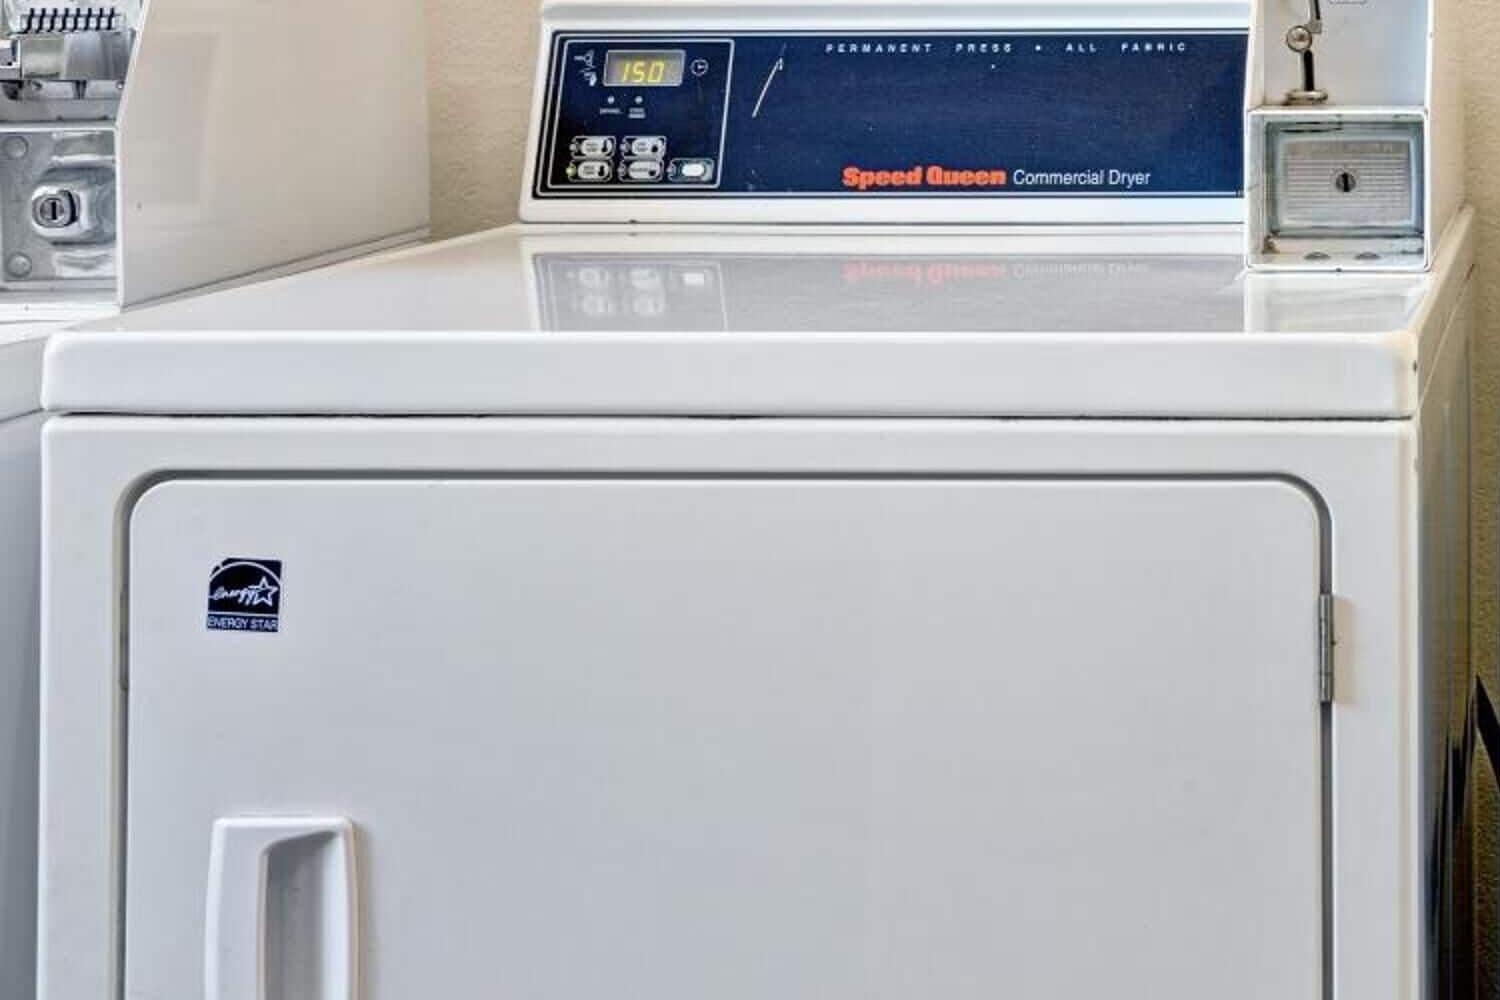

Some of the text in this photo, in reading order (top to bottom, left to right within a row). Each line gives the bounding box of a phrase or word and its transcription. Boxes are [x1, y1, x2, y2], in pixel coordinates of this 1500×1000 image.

[825, 42, 1186, 53] PERMANENT PRESS ALL FABRIC
[623, 61, 665, 83] 150
[842, 166, 1151, 190] Speed Queen Commercial Dryer
[208, 616, 279, 630] ENERGY STAR
